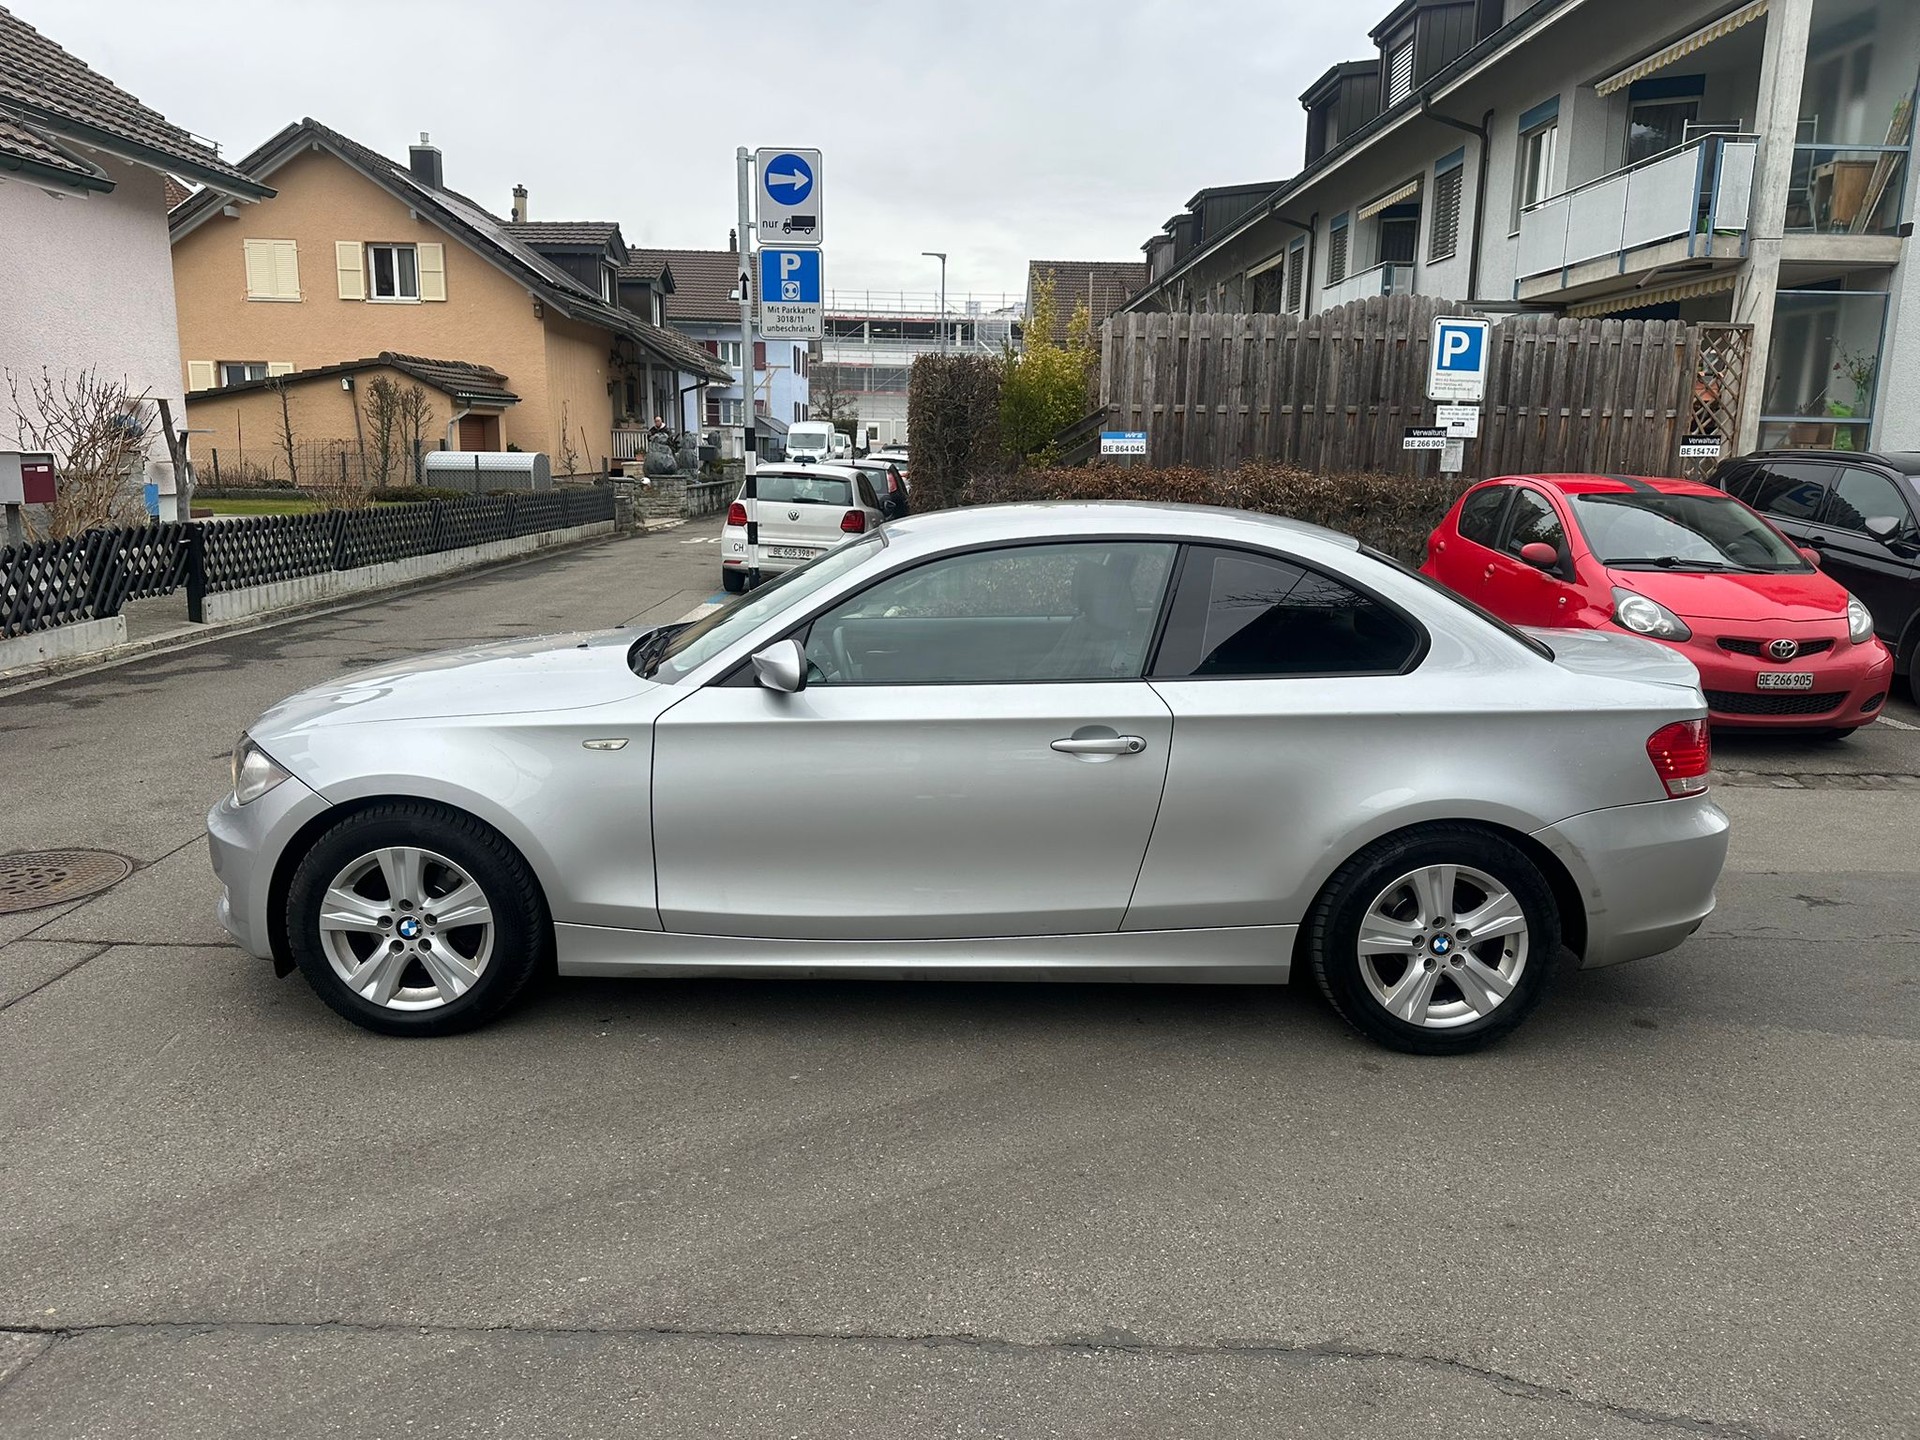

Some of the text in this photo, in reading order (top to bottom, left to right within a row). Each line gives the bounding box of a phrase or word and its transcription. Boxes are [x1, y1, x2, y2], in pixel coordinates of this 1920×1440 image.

[762, 219, 779, 228] nur
[781, 253, 801, 279] P
[782, 306, 816, 314] Parkkarte
[777, 315, 804, 323] 3018/11
[1442, 330, 1470, 367] P
[1412, 429, 1447, 437] Verwaltung
[1688, 437, 1720, 445] Verwaltung
[733, 543, 744, 552] CH
[773, 547, 782, 555] BE
[1759, 675, 1771, 685] BE
